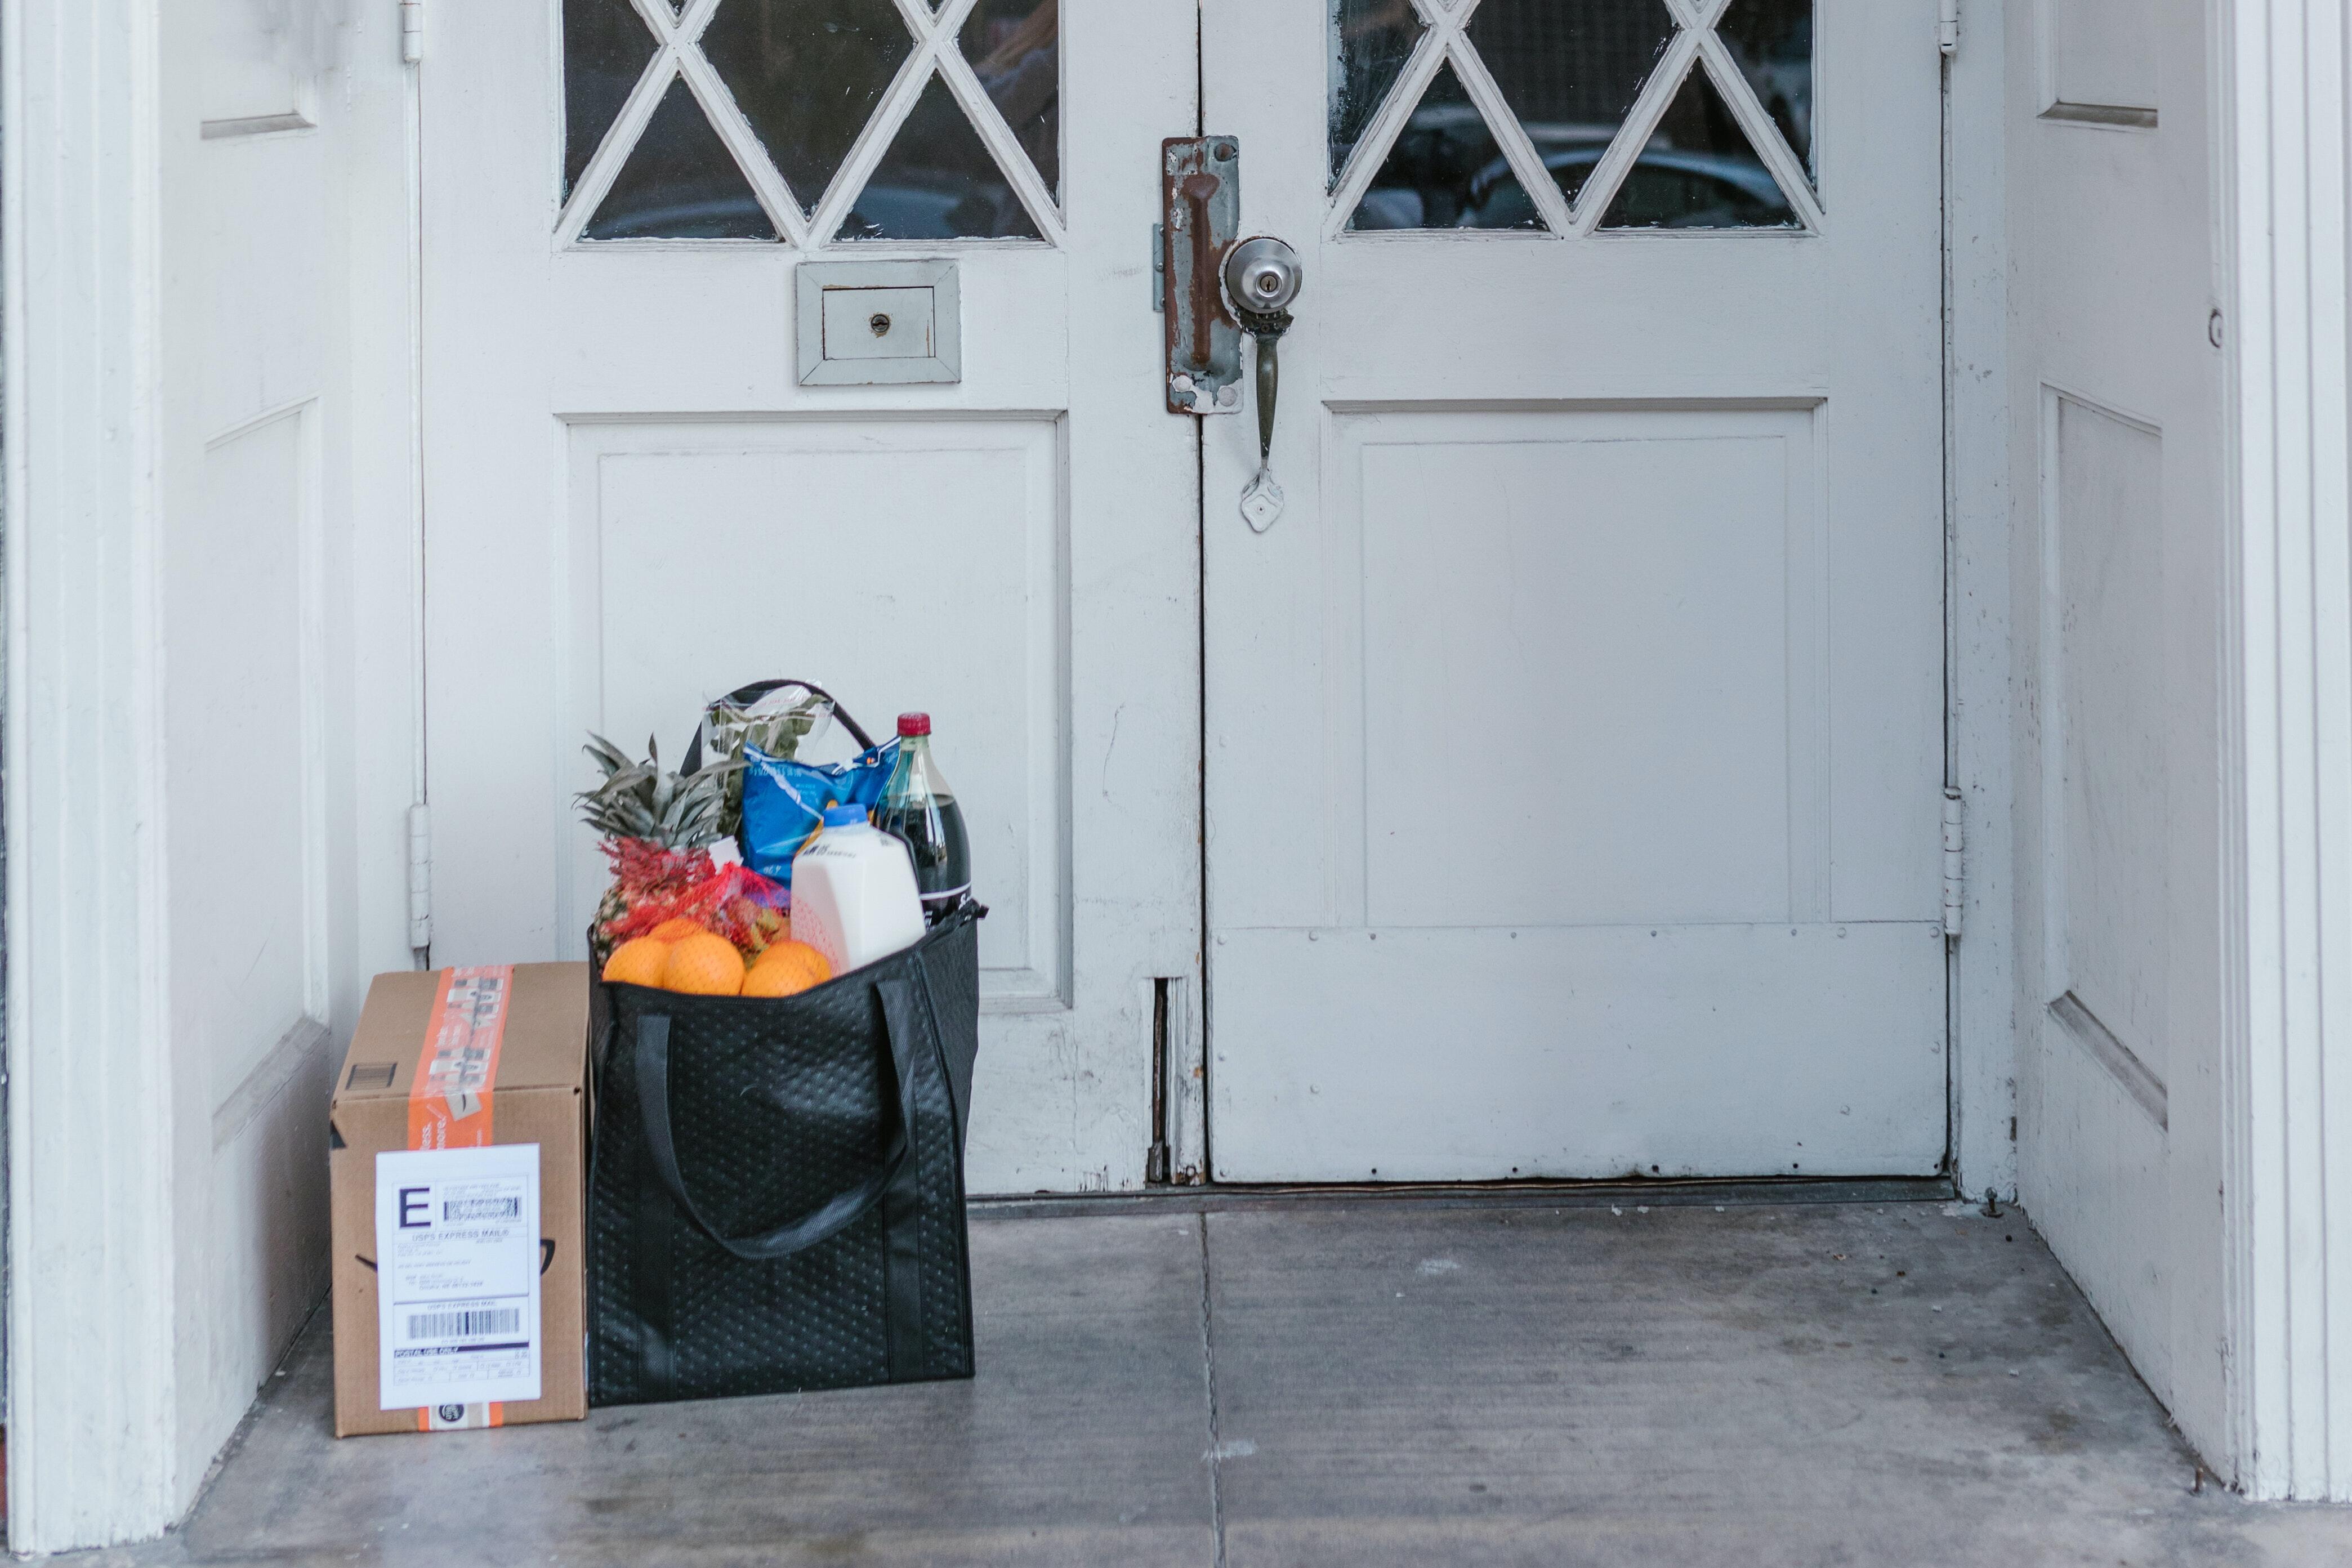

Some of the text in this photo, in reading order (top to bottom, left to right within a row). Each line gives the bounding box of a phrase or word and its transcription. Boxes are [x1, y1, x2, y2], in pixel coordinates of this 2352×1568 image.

[399, 1187, 431, 1229] E
[412, 1233, 435, 1241] USPS
[438, 1231, 479, 1240] EXPRESS
[395, 1350, 421, 1358] POSTAL
[439, 1346, 459, 1355] ONLY
